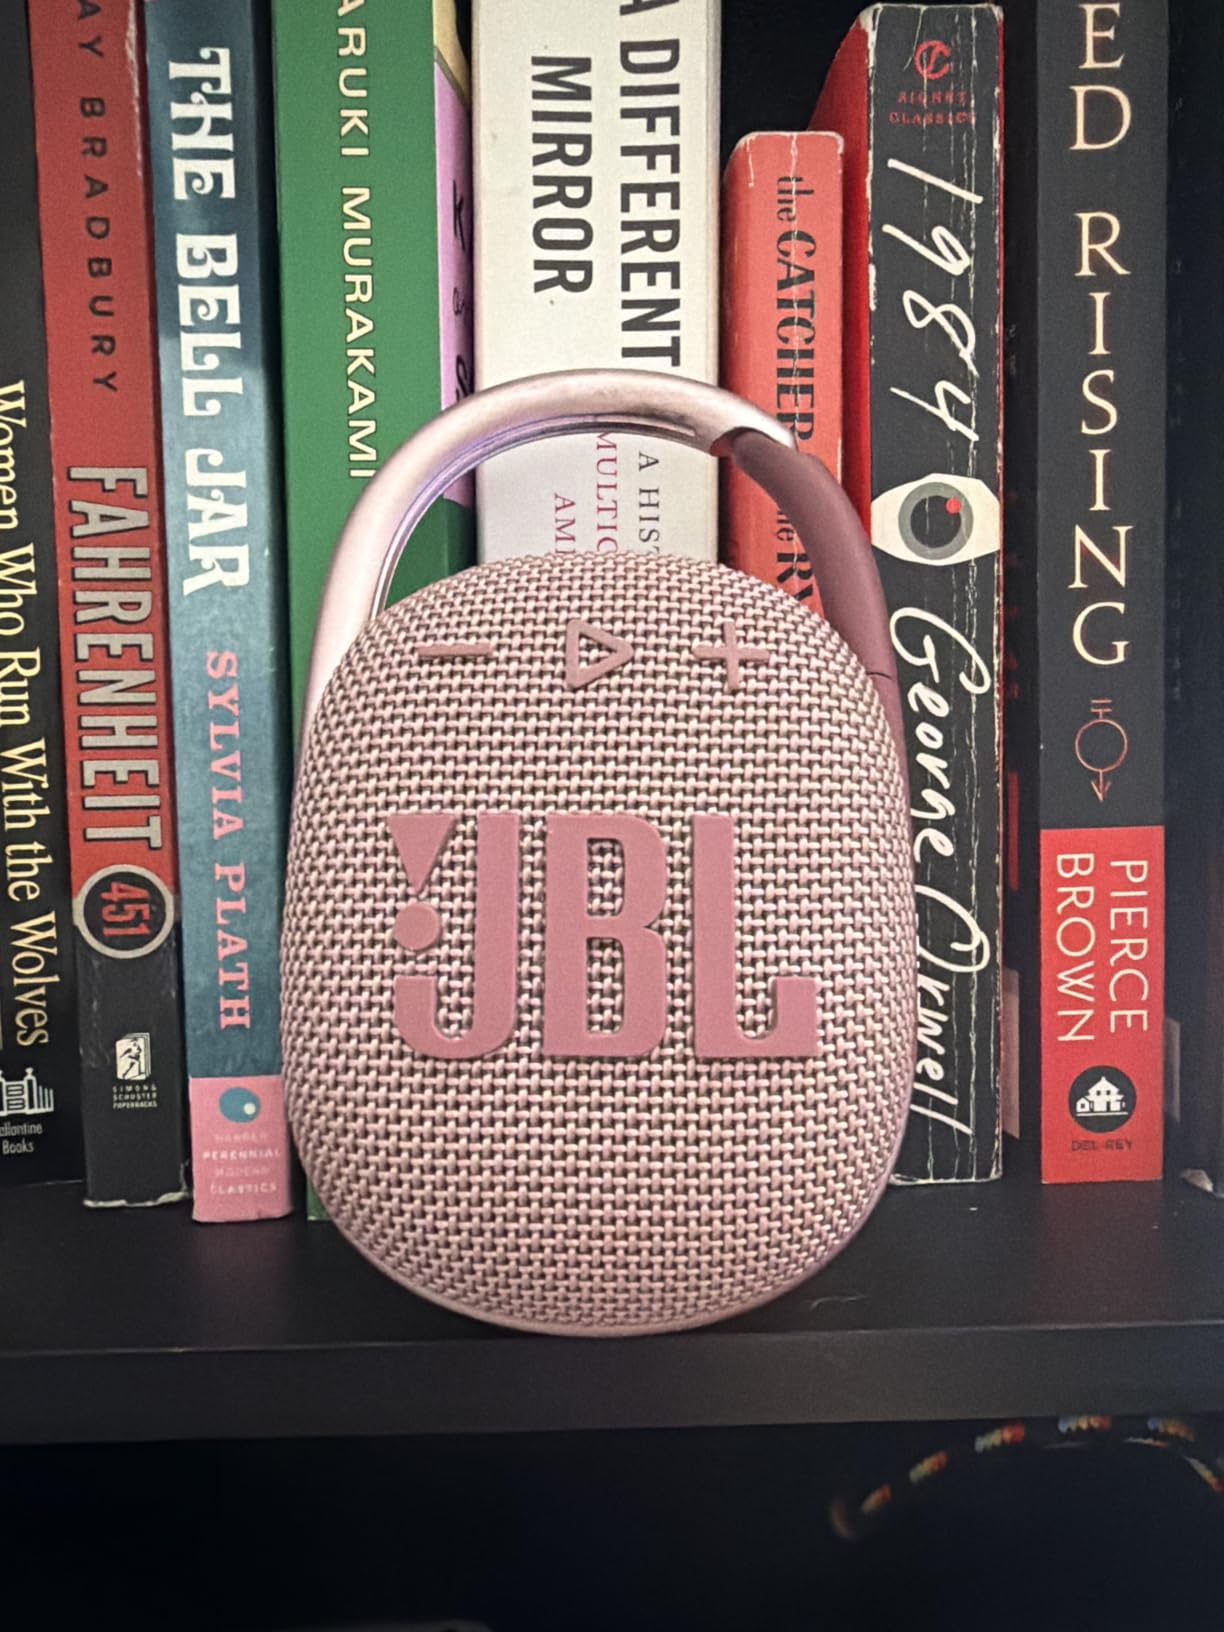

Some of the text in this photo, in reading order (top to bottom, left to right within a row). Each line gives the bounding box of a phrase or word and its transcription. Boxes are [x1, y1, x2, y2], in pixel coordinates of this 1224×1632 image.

[79, 97, 118, 393] BRADBURY
[531, 56, 593, 293] MIRROR
[619, 39, 681, 367] DIFFERENT
[775, 175, 817, 441] the CATCHER
[882, 158, 983, 442] 1984
[168, 47, 250, 597] THE BELL JAR
[341, 186, 377, 478] MURAKAMI
[638, 450, 660, 472] A
[1067, 211, 1135, 665] RISING
[0, 380, 61, 1047] Women Who Run With the Wolves
[68, 466, 162, 848] FAHRENHEIT
[101, 881, 150, 938] 451
[206, 651, 251, 1030] SYLVIA PLATH
[387, 813, 820, 1059] JBL
[889, 607, 991, 1135] George Orwell
[1056, 852, 1096, 1043] BROWN
[1109, 860, 1149, 1033] PIERCE
[2, 1138, 34, 1155] Books
[1071, 1138, 1132, 1151] DEL REY
